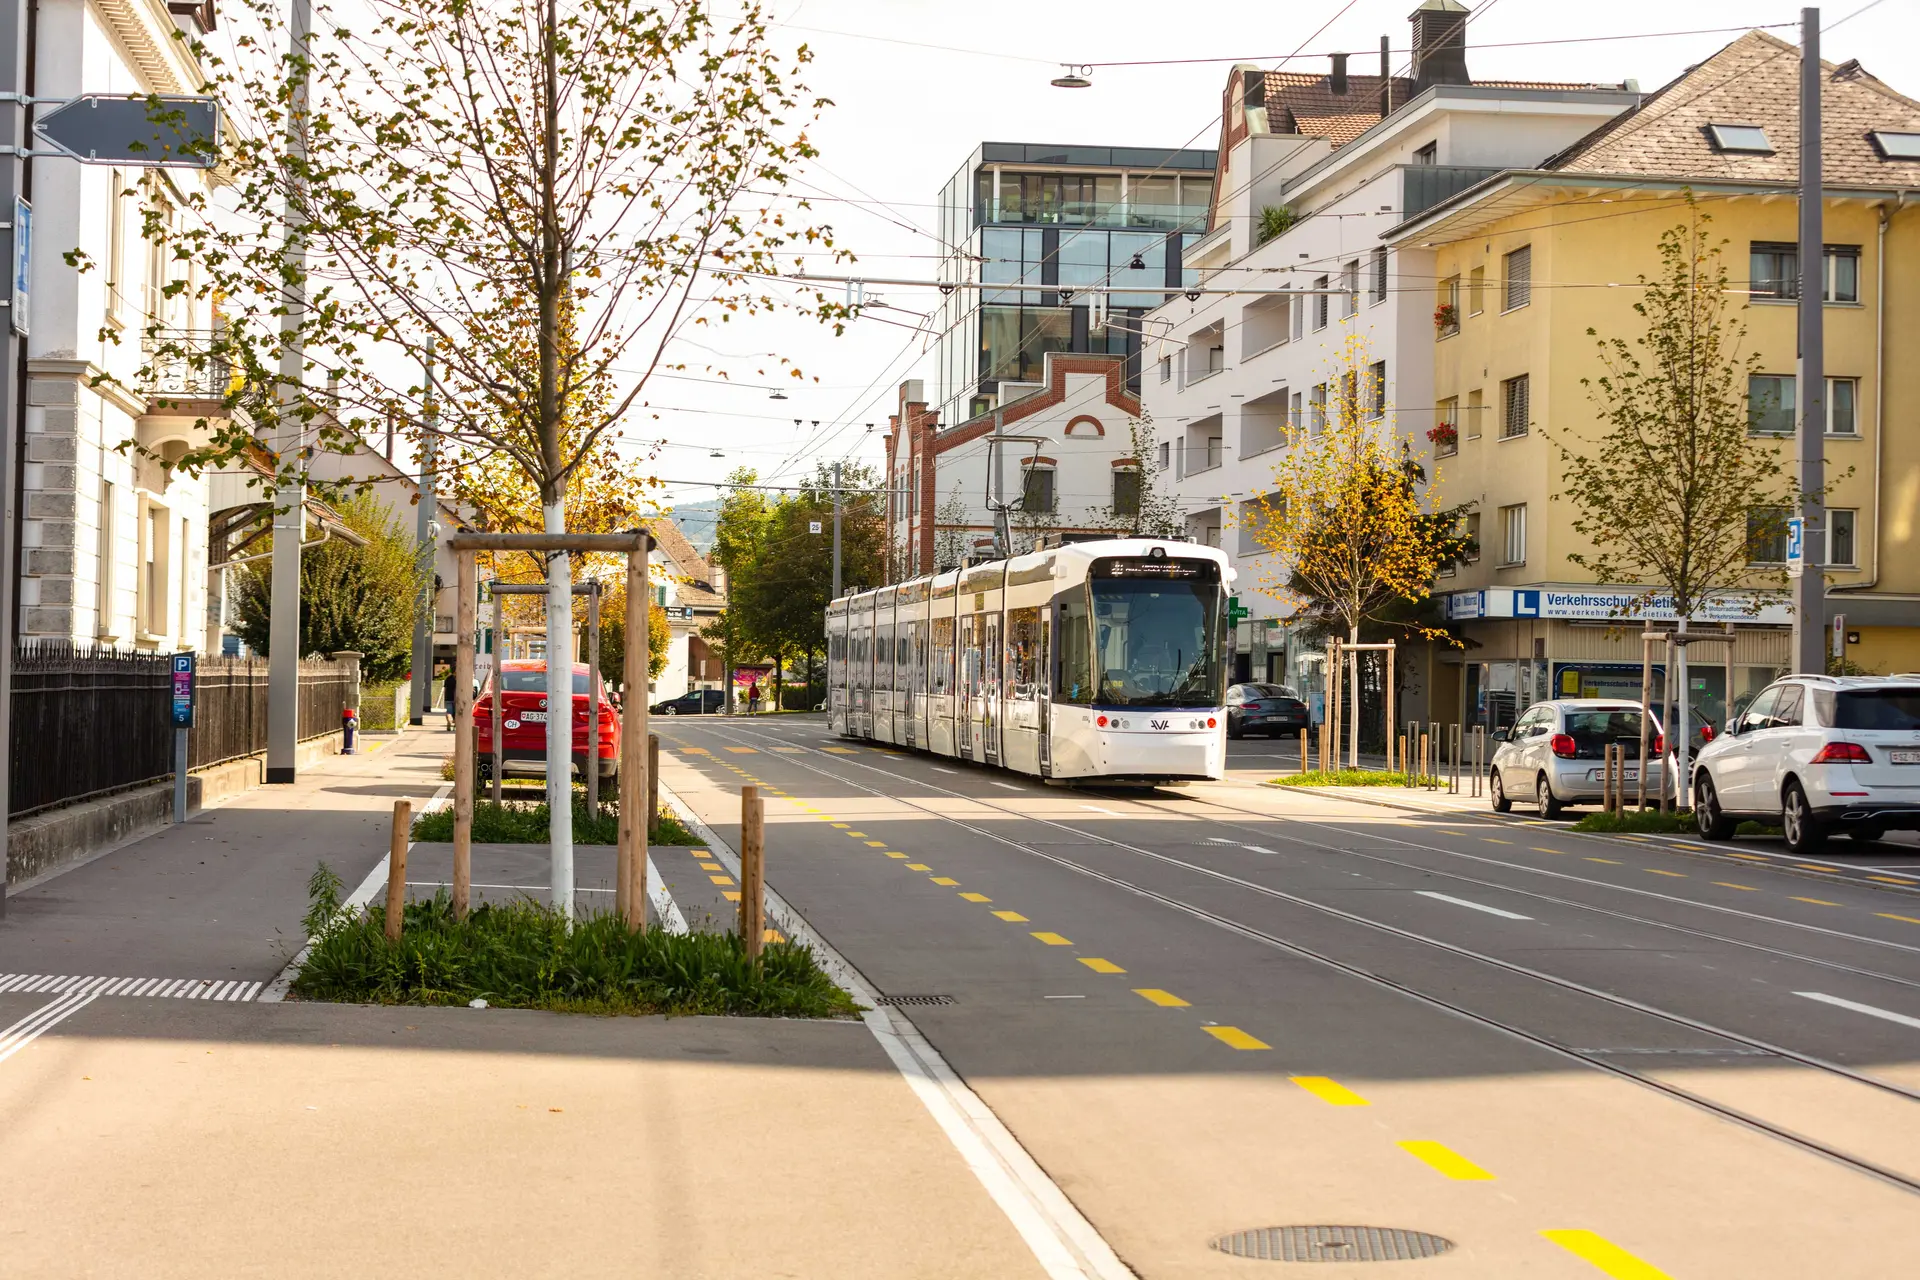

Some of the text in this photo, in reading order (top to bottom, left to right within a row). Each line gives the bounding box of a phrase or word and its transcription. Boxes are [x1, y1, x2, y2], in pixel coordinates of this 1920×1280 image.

[1790, 524, 1798, 554] P
[1517, 593, 1536, 614] L
[178, 659, 188, 671] P
[178, 714, 185, 722] 5
[507, 720, 517, 728] CH
